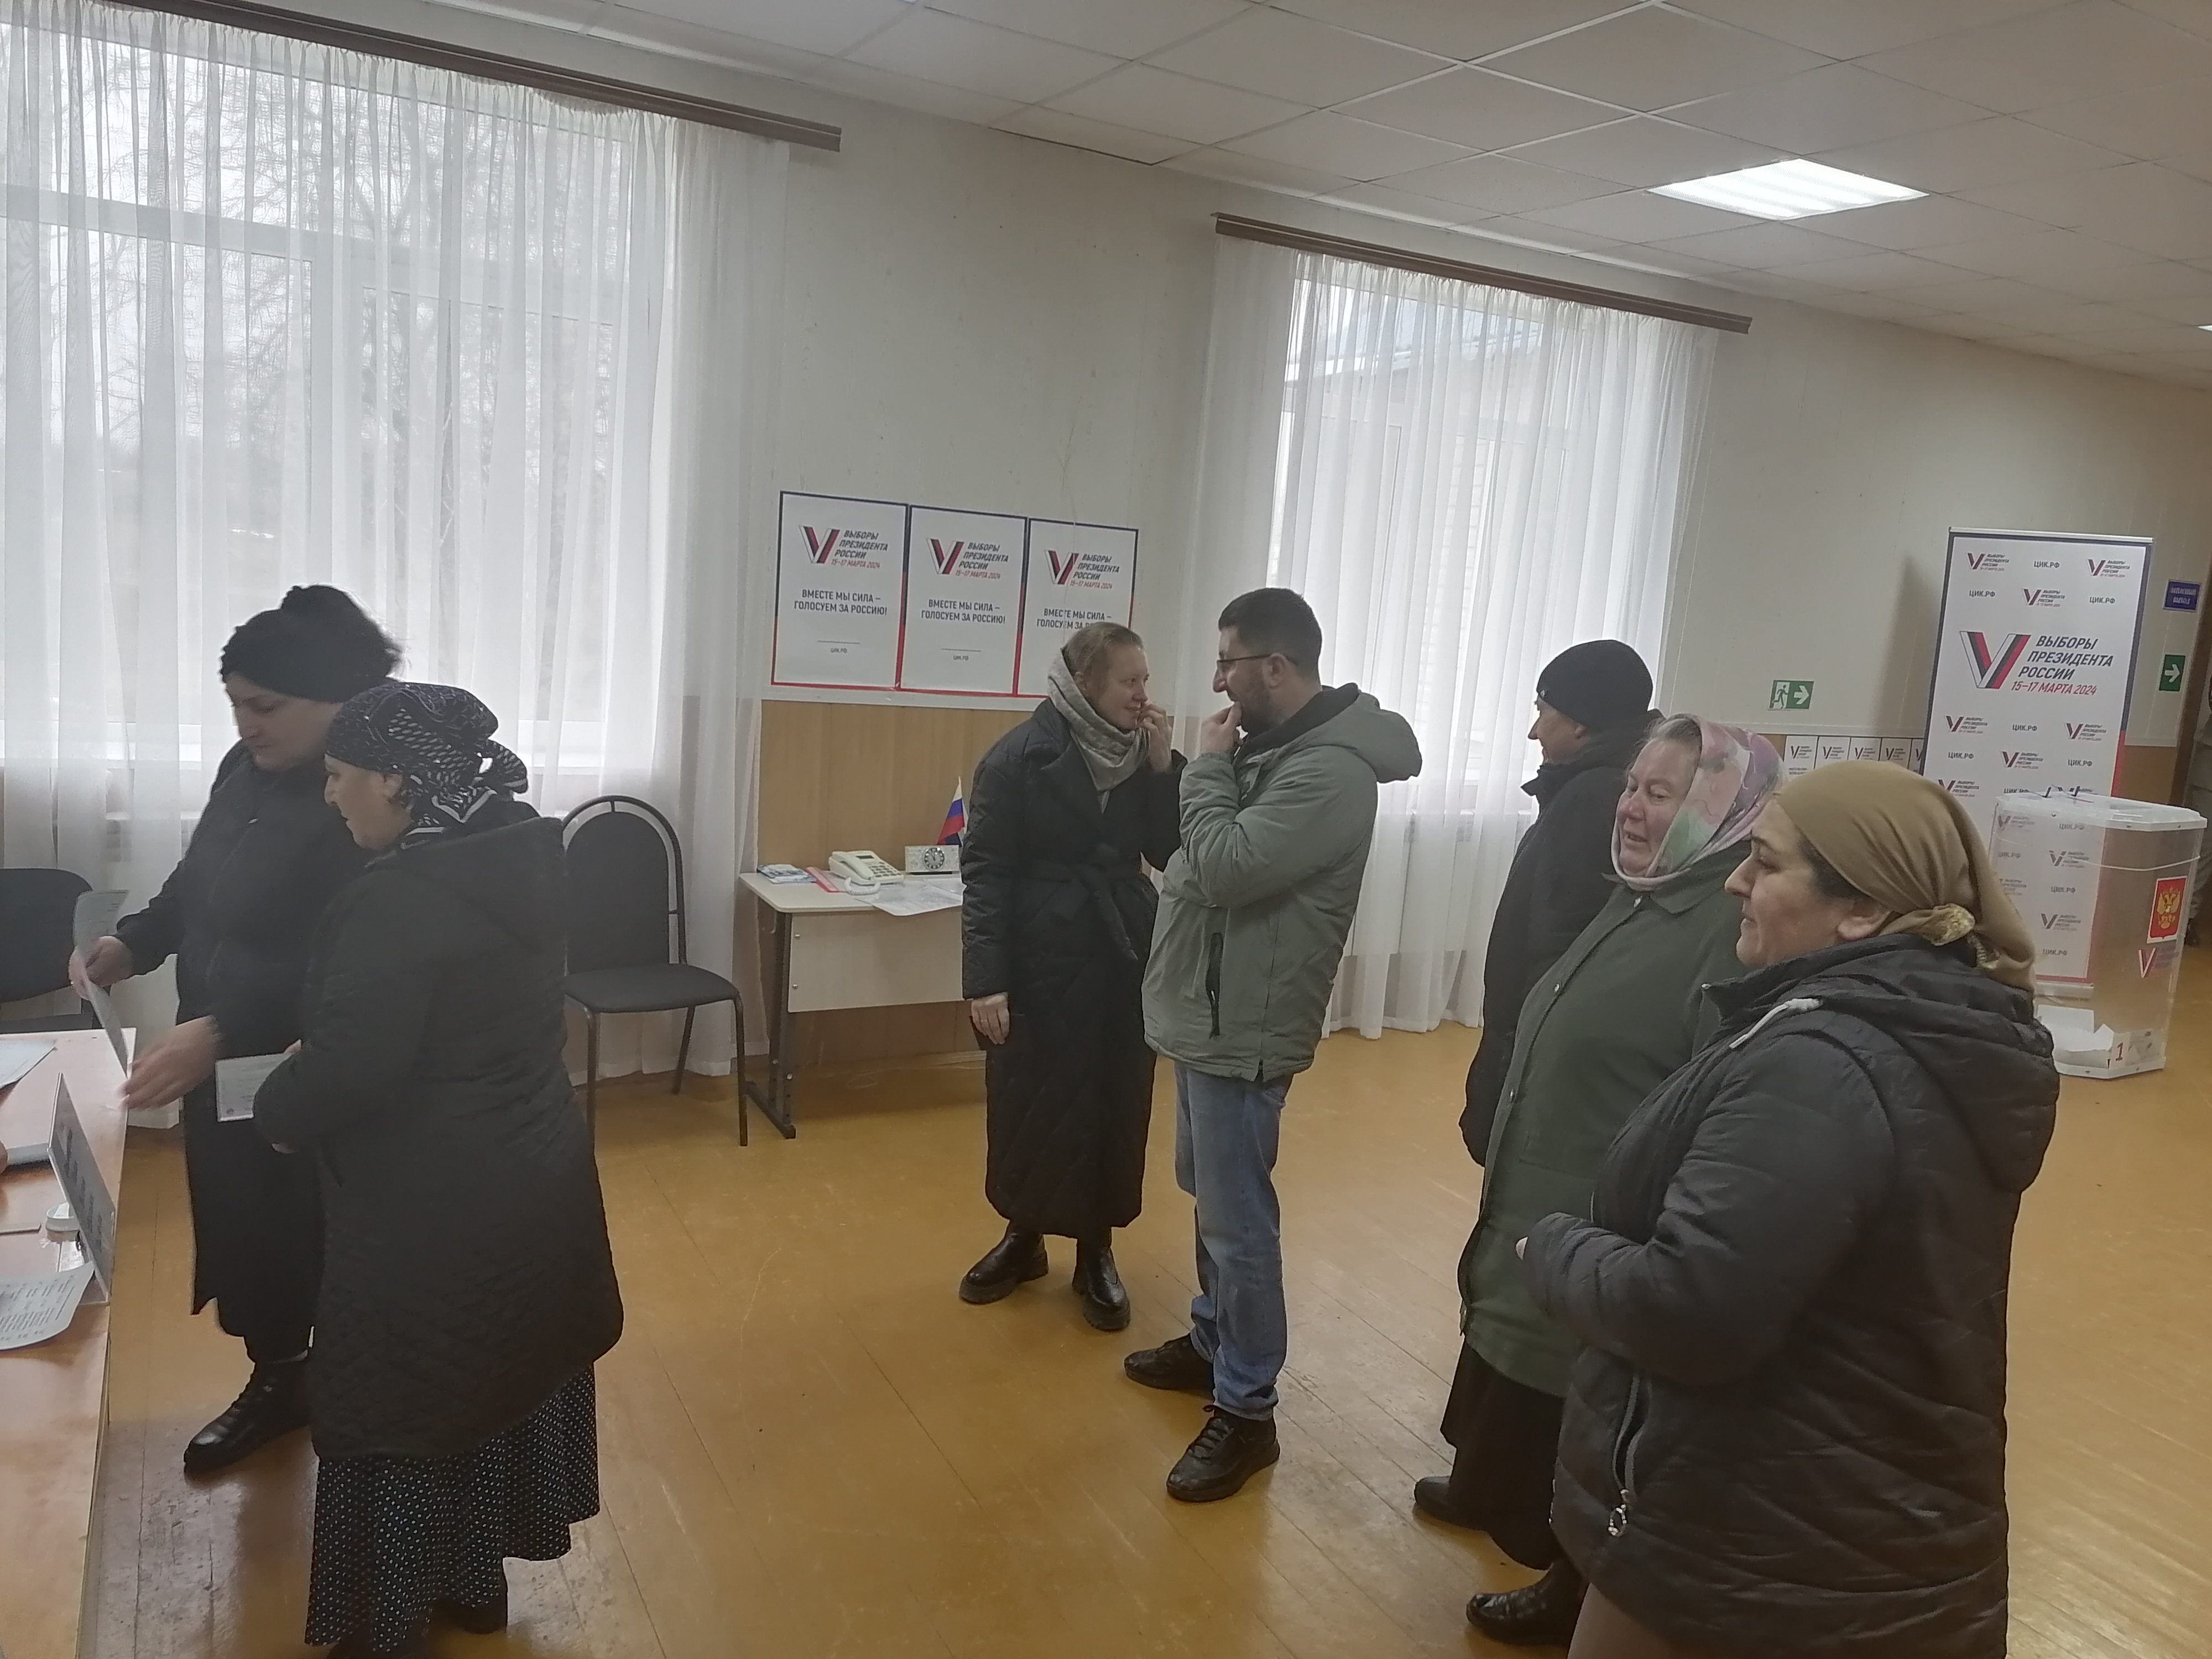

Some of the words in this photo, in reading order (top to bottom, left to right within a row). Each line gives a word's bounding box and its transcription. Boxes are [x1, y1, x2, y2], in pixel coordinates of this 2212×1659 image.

[844, 530, 879, 540] ВЫБОРЫ
[839, 540, 889, 551] ПРЕЗИДЕНТА
[967, 542, 1000, 552] ВЫБОРЫ
[834, 550, 867, 559] РОССИИ
[963, 551, 1009, 562] ПРЕЗИДЕНТА
[1082, 554, 1112, 563] ВЫБОРЫ
[959, 561, 989, 570] РОССИИ
[1077, 562, 1120, 573] ПРЕЗИДЕНТА
[1073, 571, 1100, 581] РОССИИ
[802, 589, 833, 600] ВМЕСТЕ
[836, 592, 850, 601] МЫ
[852, 593, 874, 602] СИЛА
[794, 601, 837, 612] ГОЛОСУЕМ
[839, 603, 849, 613] ЗА
[851, 606, 887, 615] РОССИЮ!
[928, 599, 957, 609] ВМЕСТЕ
[959, 601, 972, 610] МЫ
[974, 602, 993, 612] СИЛА
[921, 610, 959, 620] ГОЛОСУЕМ
[962, 613, 971, 622] ЗА
[972, 614, 1005, 624] РОССИЮ!
[1044, 608, 1071, 618] ВМЕСТЕ
[1073, 610, 1086, 619] МЫ
[1087, 612, 1105, 620] СИЛА
[2036, 635, 2099, 650] ВЫБОРЫ
[2027, 650, 2114, 667] ПРЕЗИДЕНТА
[2018, 666, 2075, 680] РОССИИ
[2038, 683, 2073, 695] МАРТА
[2073, 685, 2097, 696] 2024
[2115, 1042, 2124, 1062] 1
